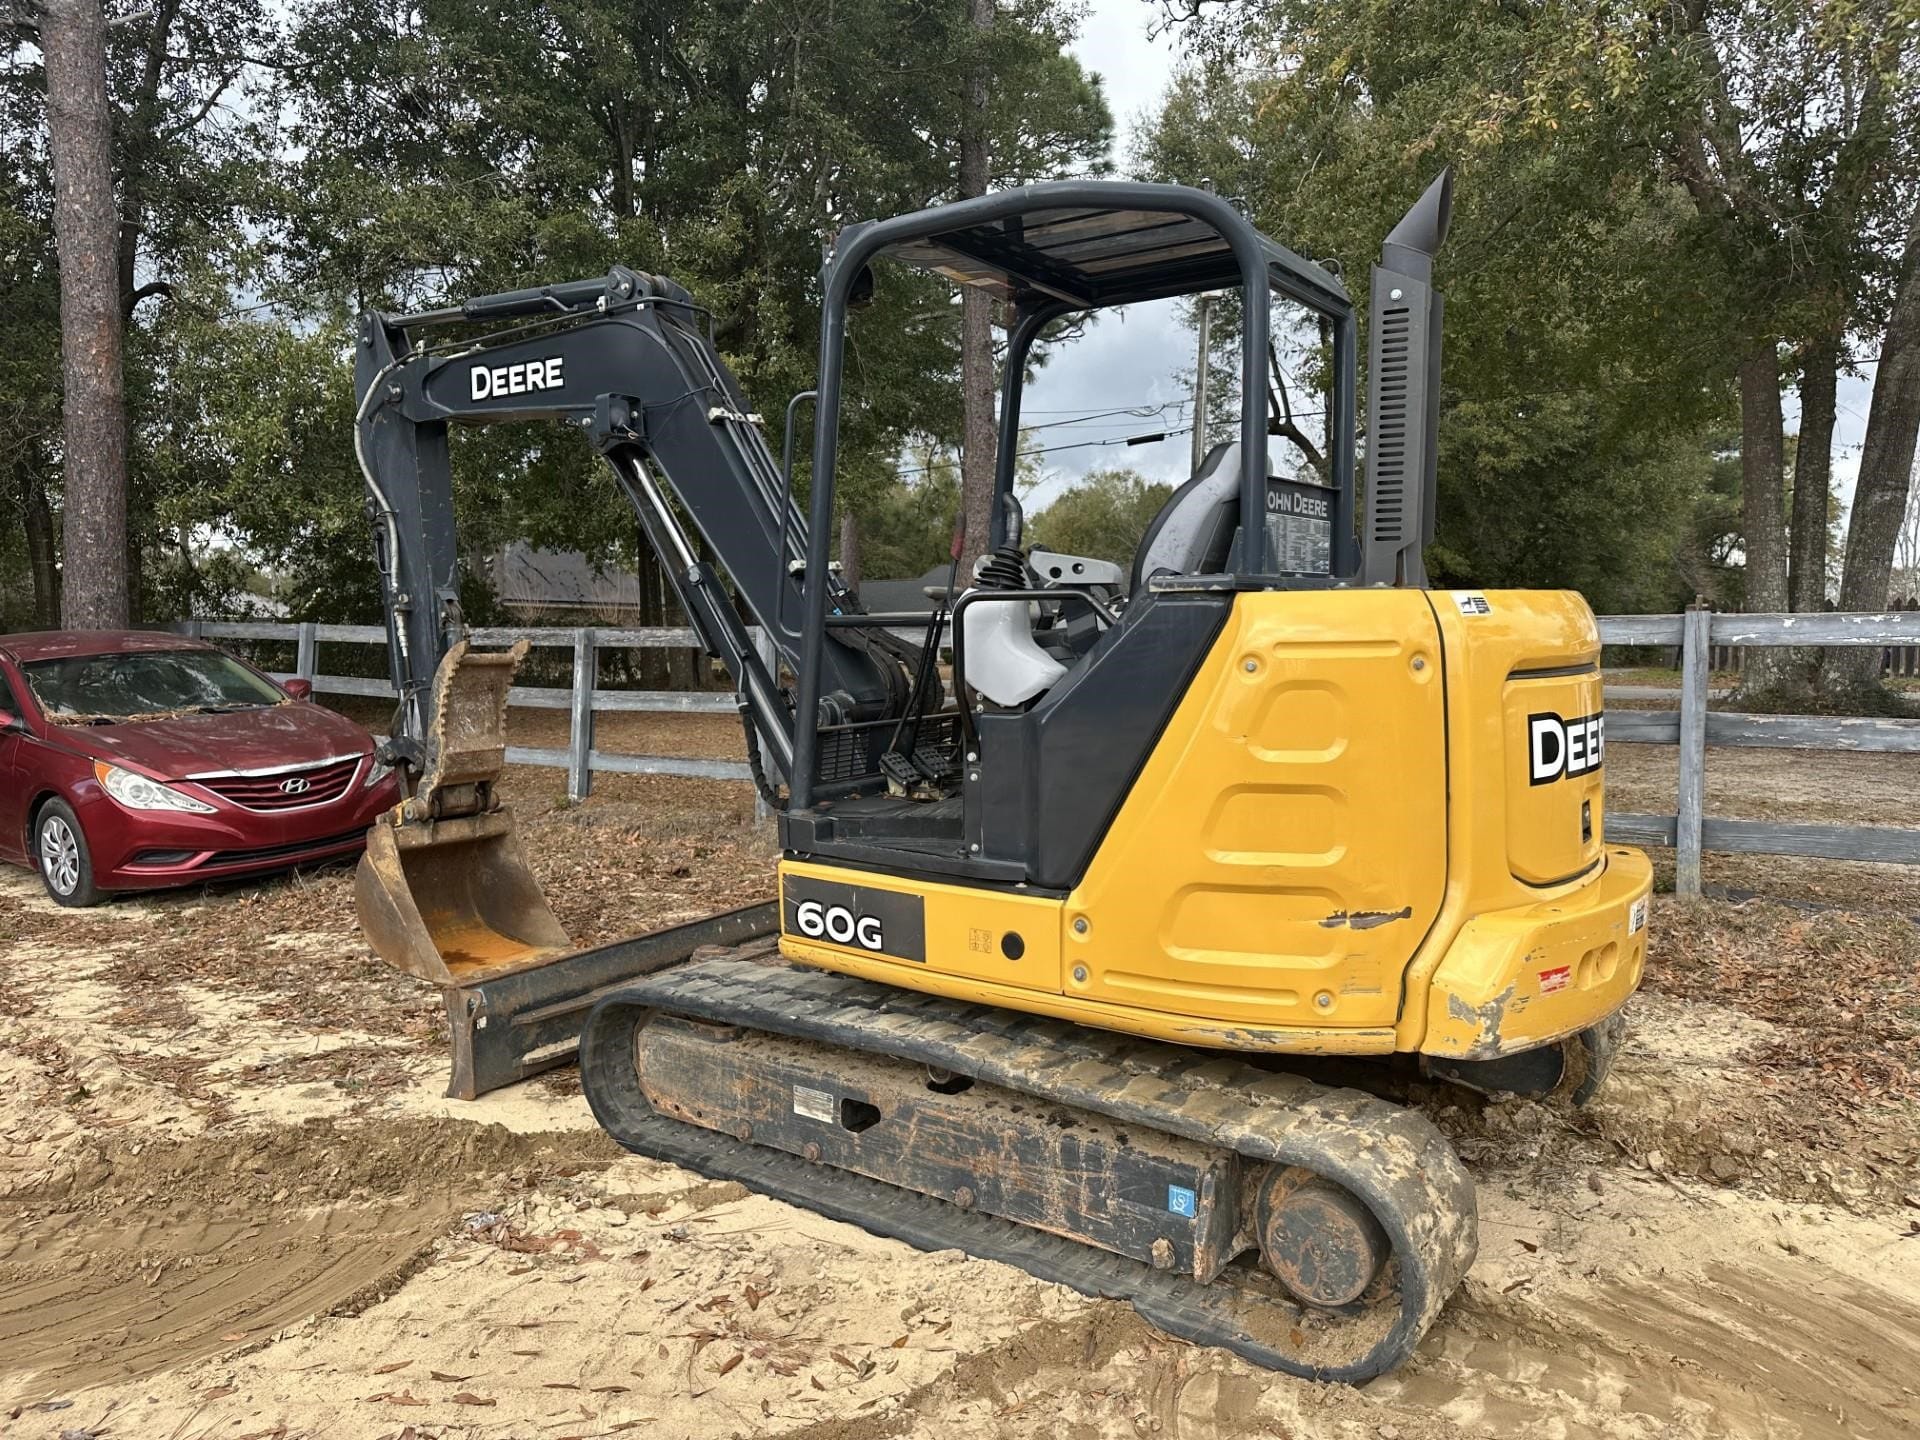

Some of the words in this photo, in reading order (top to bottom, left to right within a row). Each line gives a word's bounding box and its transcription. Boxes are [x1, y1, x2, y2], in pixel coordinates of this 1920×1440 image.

[471, 357, 564, 400] DEERE
[1267, 491, 1292, 512] OHN
[1293, 492, 1328, 517] DEERE
[1531, 717, 1604, 779] DEER
[797, 901, 882, 950] 60G
